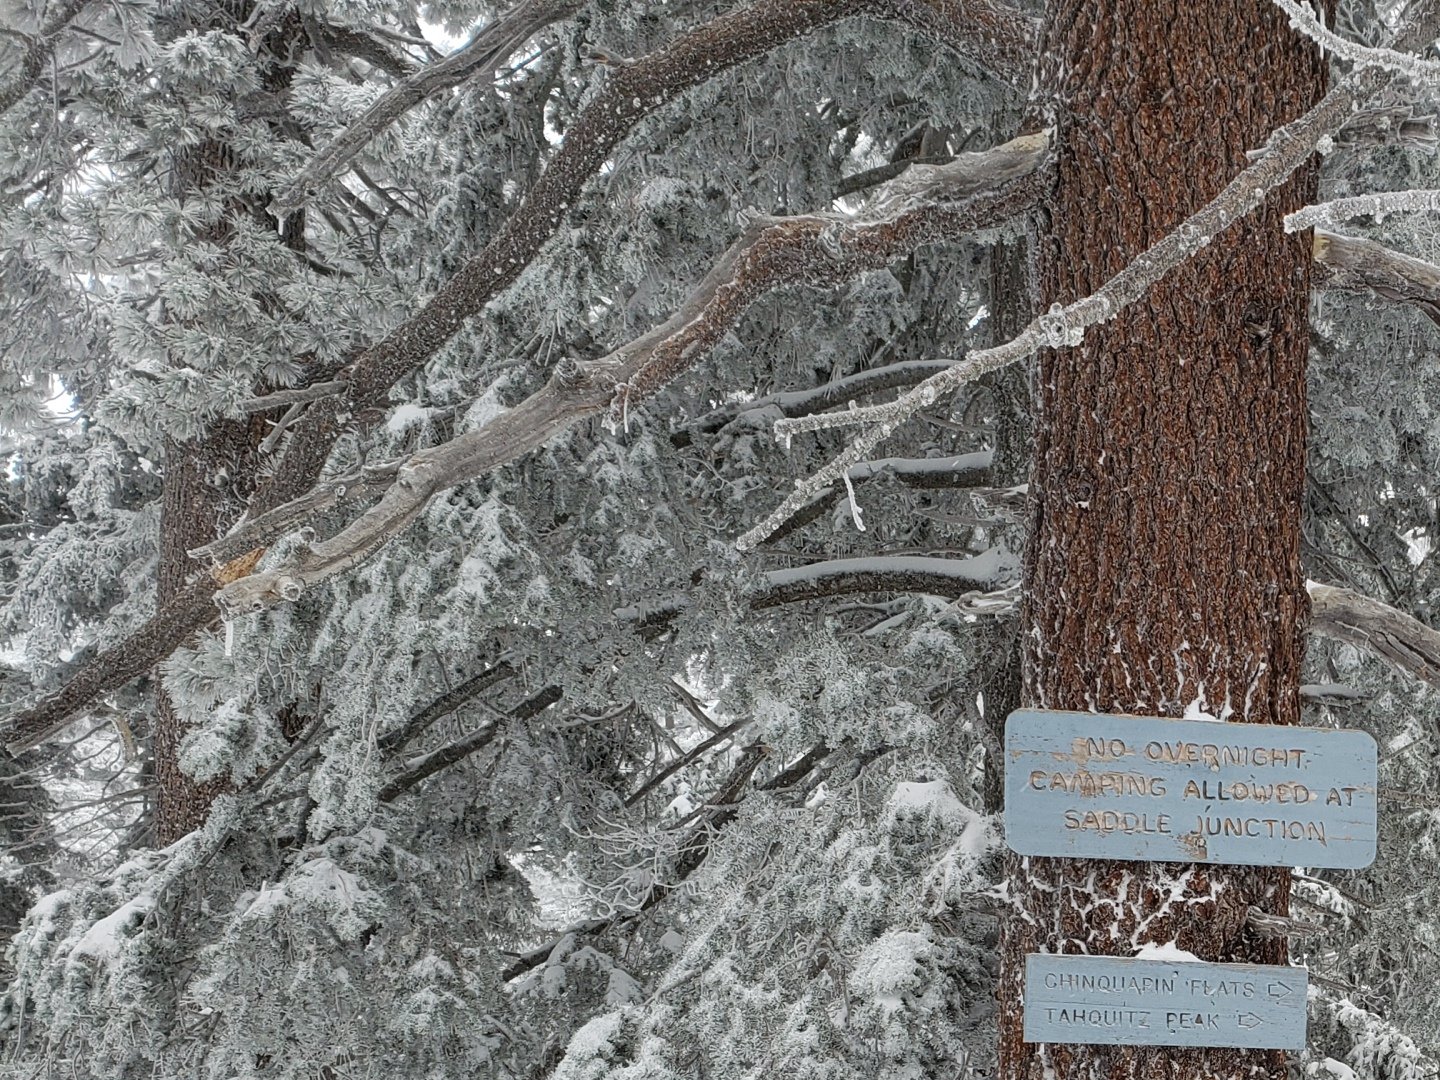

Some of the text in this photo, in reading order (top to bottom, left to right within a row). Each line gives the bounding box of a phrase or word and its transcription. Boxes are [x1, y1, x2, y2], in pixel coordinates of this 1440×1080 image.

[1085, 737, 1306, 769] NO OVERNIGHT
[1029, 770, 1357, 807] CAMPING ALLOWED AT
[1064, 809, 1326, 842] SADDLE JUNCTION
[1044, 973, 1255, 997] CHINQUAPIN FLATS
[1044, 1008, 1220, 1030] TAHQUITZ PEAK
